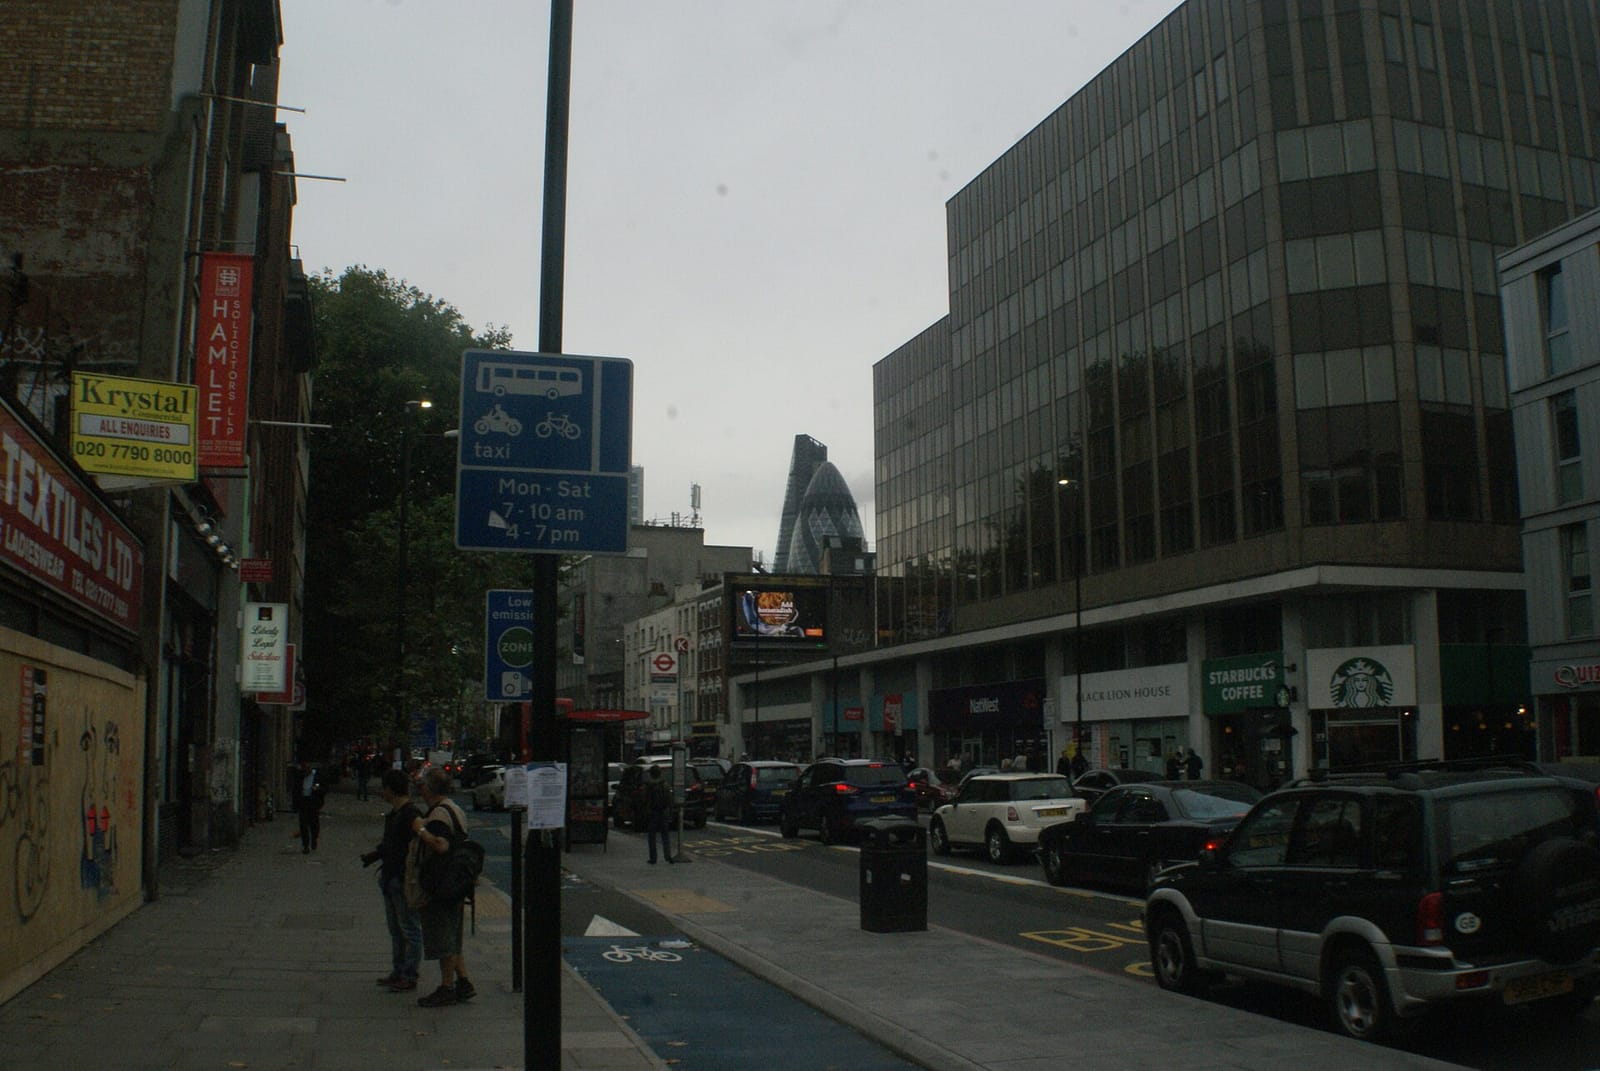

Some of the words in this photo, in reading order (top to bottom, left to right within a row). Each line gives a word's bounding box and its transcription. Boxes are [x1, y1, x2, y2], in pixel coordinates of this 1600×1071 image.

[228, 300, 241, 400] SOLICITORS
[206, 299, 228, 436] HAMLET
[79, 377, 189, 414] Krystal
[100, 419, 120, 434] ALL
[121, 422, 171, 440] ENQUIRIES
[226, 407, 235, 436] LLP
[76, 441, 106, 457] 020
[112, 444, 149, 461] 7790
[154, 448, 192, 465] 8000
[473, 441, 511, 459] taxi
[499, 478, 541, 496] Mon
[558, 480, 592, 498] Sat
[3, 431, 104, 572] TEXTILES
[105, 530, 133, 592] LTD
[502, 502, 514, 519] 7
[530, 503, 550, 520] 10
[556, 507, 584, 521] am
[505, 523, 519, 540] 4
[535, 525, 547, 541] 7
[551, 529, 580, 544] pm
[4, 523, 65, 582] LADIESWEAR
[508, 595, 532, 608] Low
[501, 642, 534, 653] ZONE
[1209, 665, 1276, 685] STARBUCKS
[1106, 689, 1131, 701] LION
[1135, 686, 1171, 698] HOUSE
[1221, 684, 1264, 701] COFFEE
[969, 697, 1000, 713] NatWest
